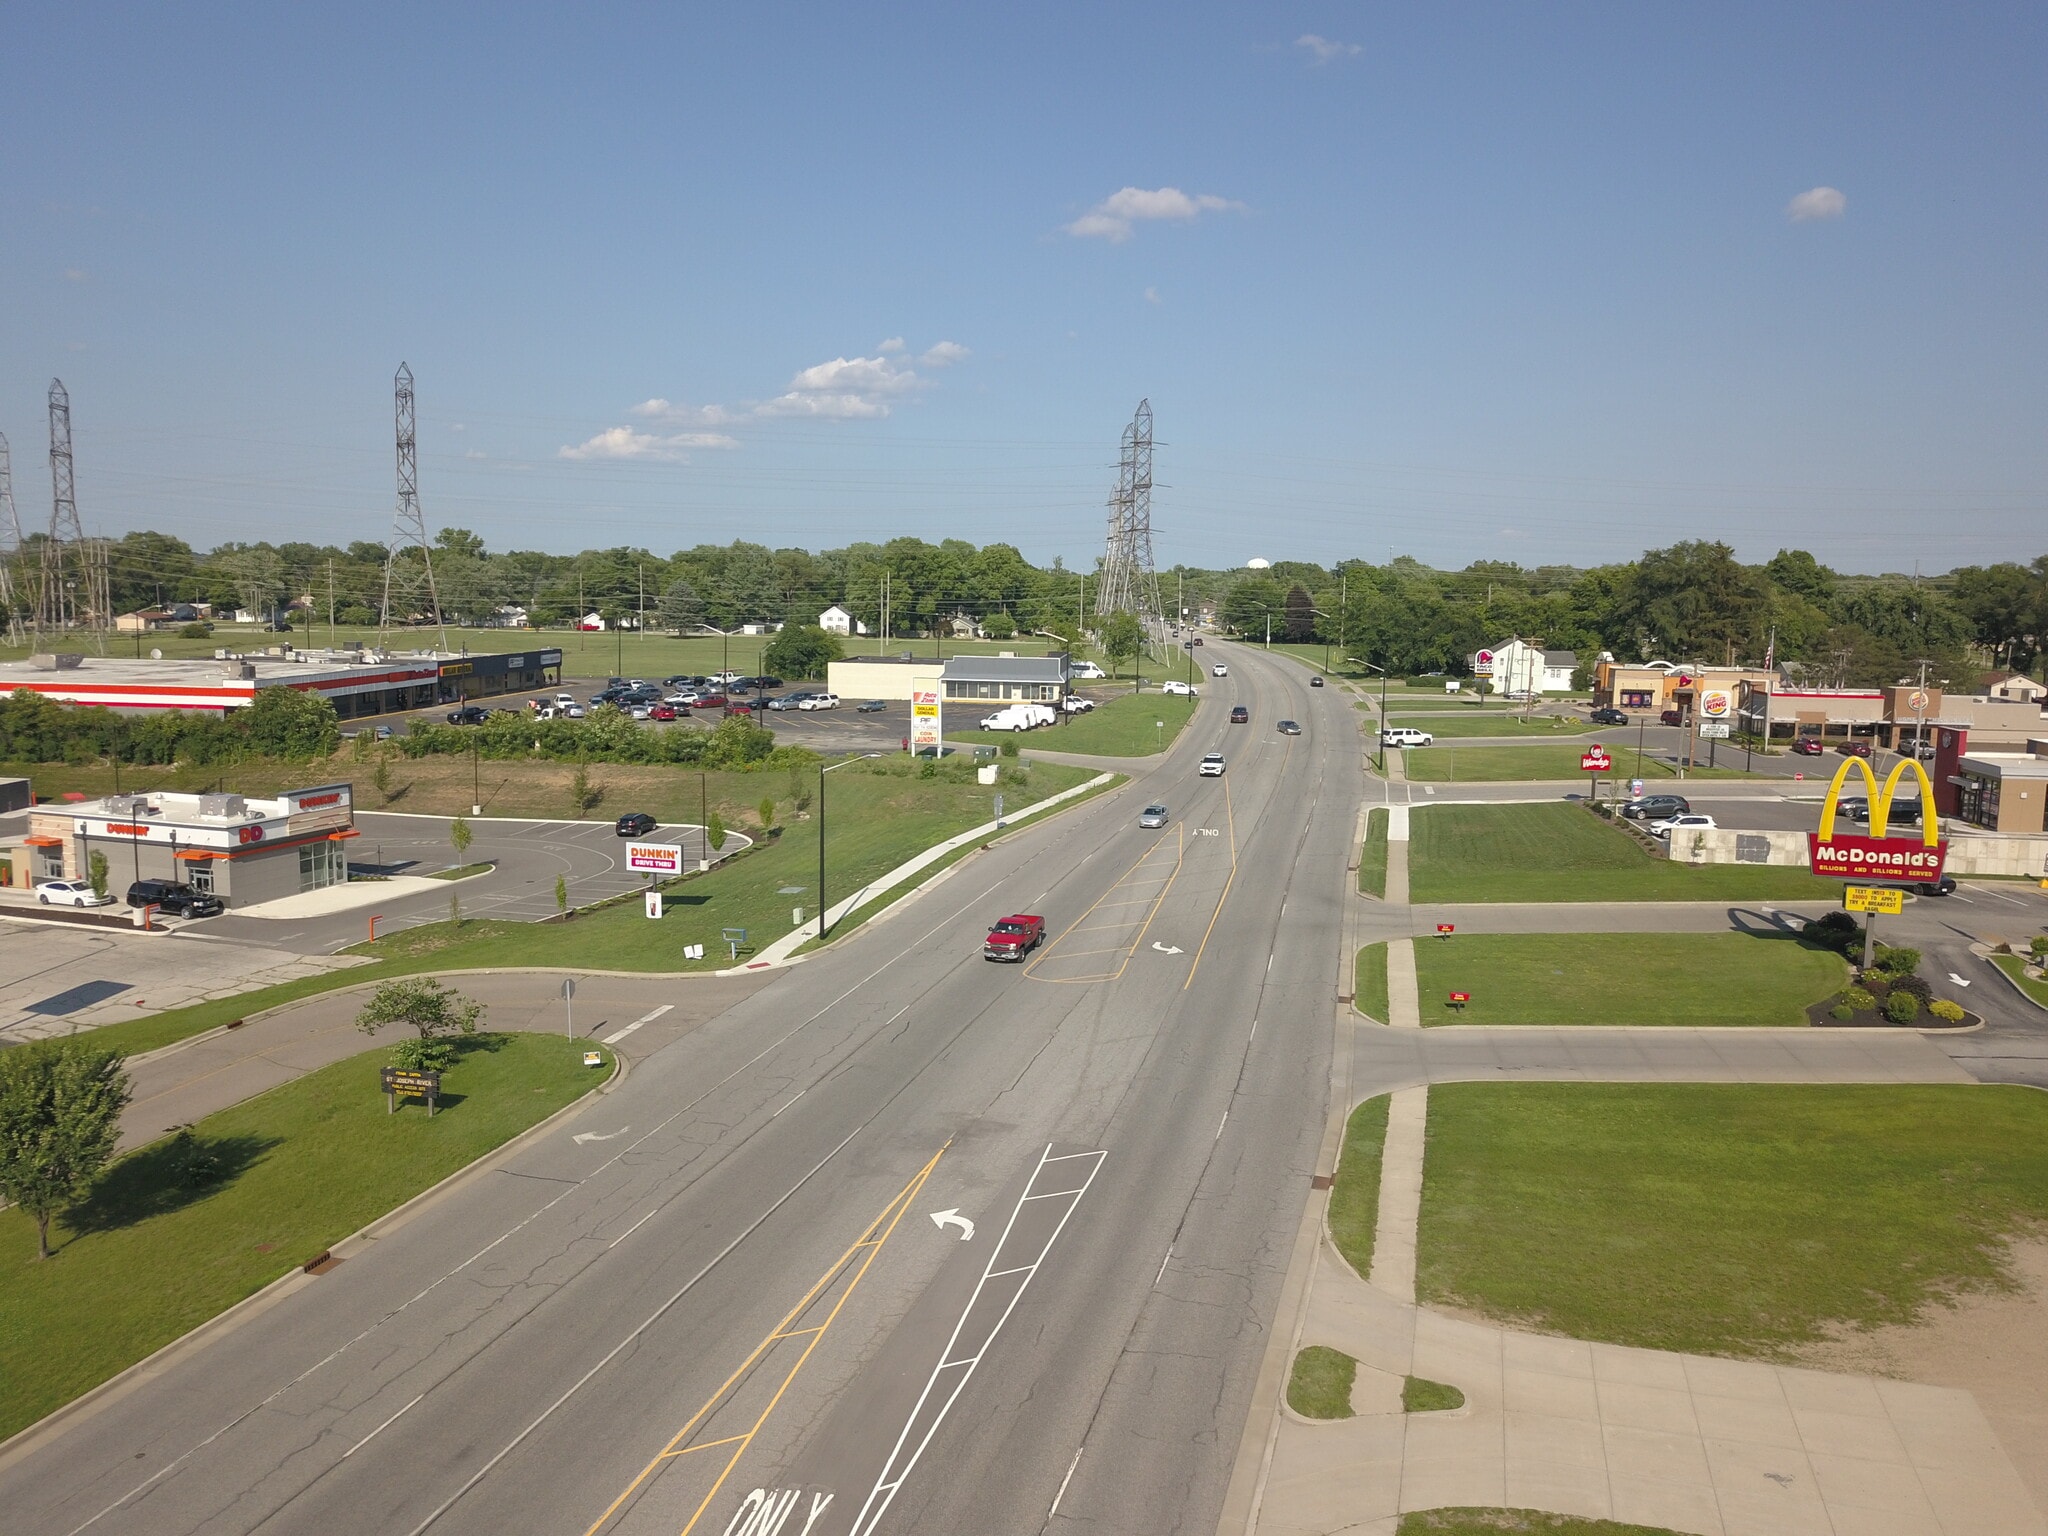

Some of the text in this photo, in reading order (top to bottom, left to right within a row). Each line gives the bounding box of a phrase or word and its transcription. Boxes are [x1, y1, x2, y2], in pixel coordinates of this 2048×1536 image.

[1706, 701, 1727, 710] KING
[1191, 828, 1219, 837] ONLY
[630, 847, 678, 860] DUNKIN'
[1816, 846, 1939, 868] McDonald's
[634, 859, 672, 868] DRIVE THRU
[1819, 864, 1848, 872] BILLIONS
[1872, 868, 1903, 876] BILLIONS
[1908, 870, 1933, 878] SERVED
